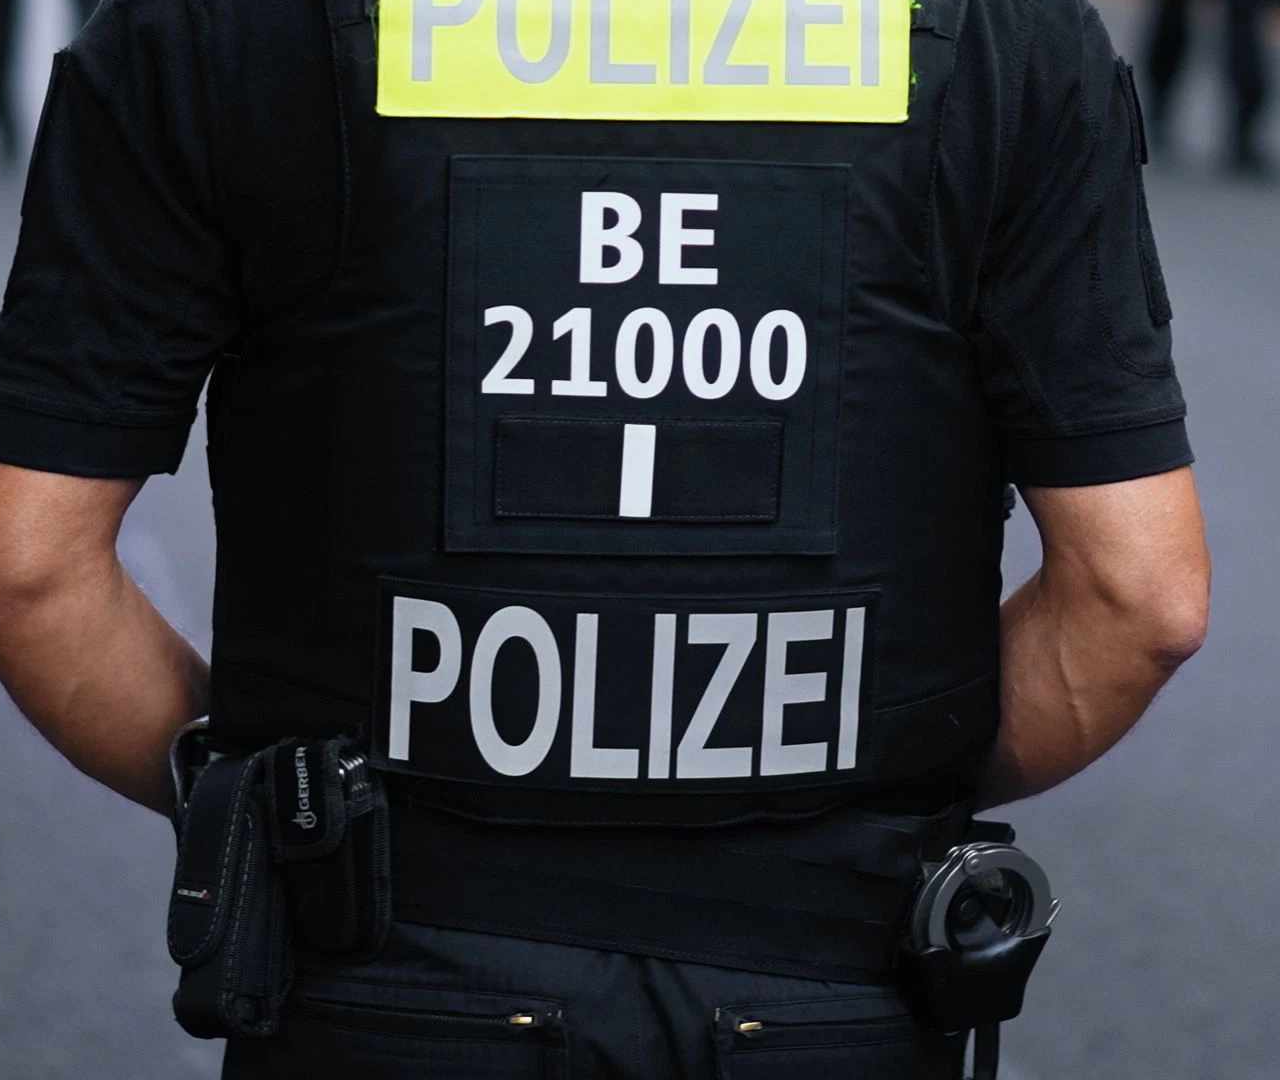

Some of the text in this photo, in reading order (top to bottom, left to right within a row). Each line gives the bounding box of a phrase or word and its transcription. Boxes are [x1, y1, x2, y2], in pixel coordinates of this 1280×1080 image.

[579, 191, 719, 285] BE
[481, 305, 807, 401] 21000
[388, 595, 866, 779] POLIZEI
[295, 745, 310, 811] GERBER
